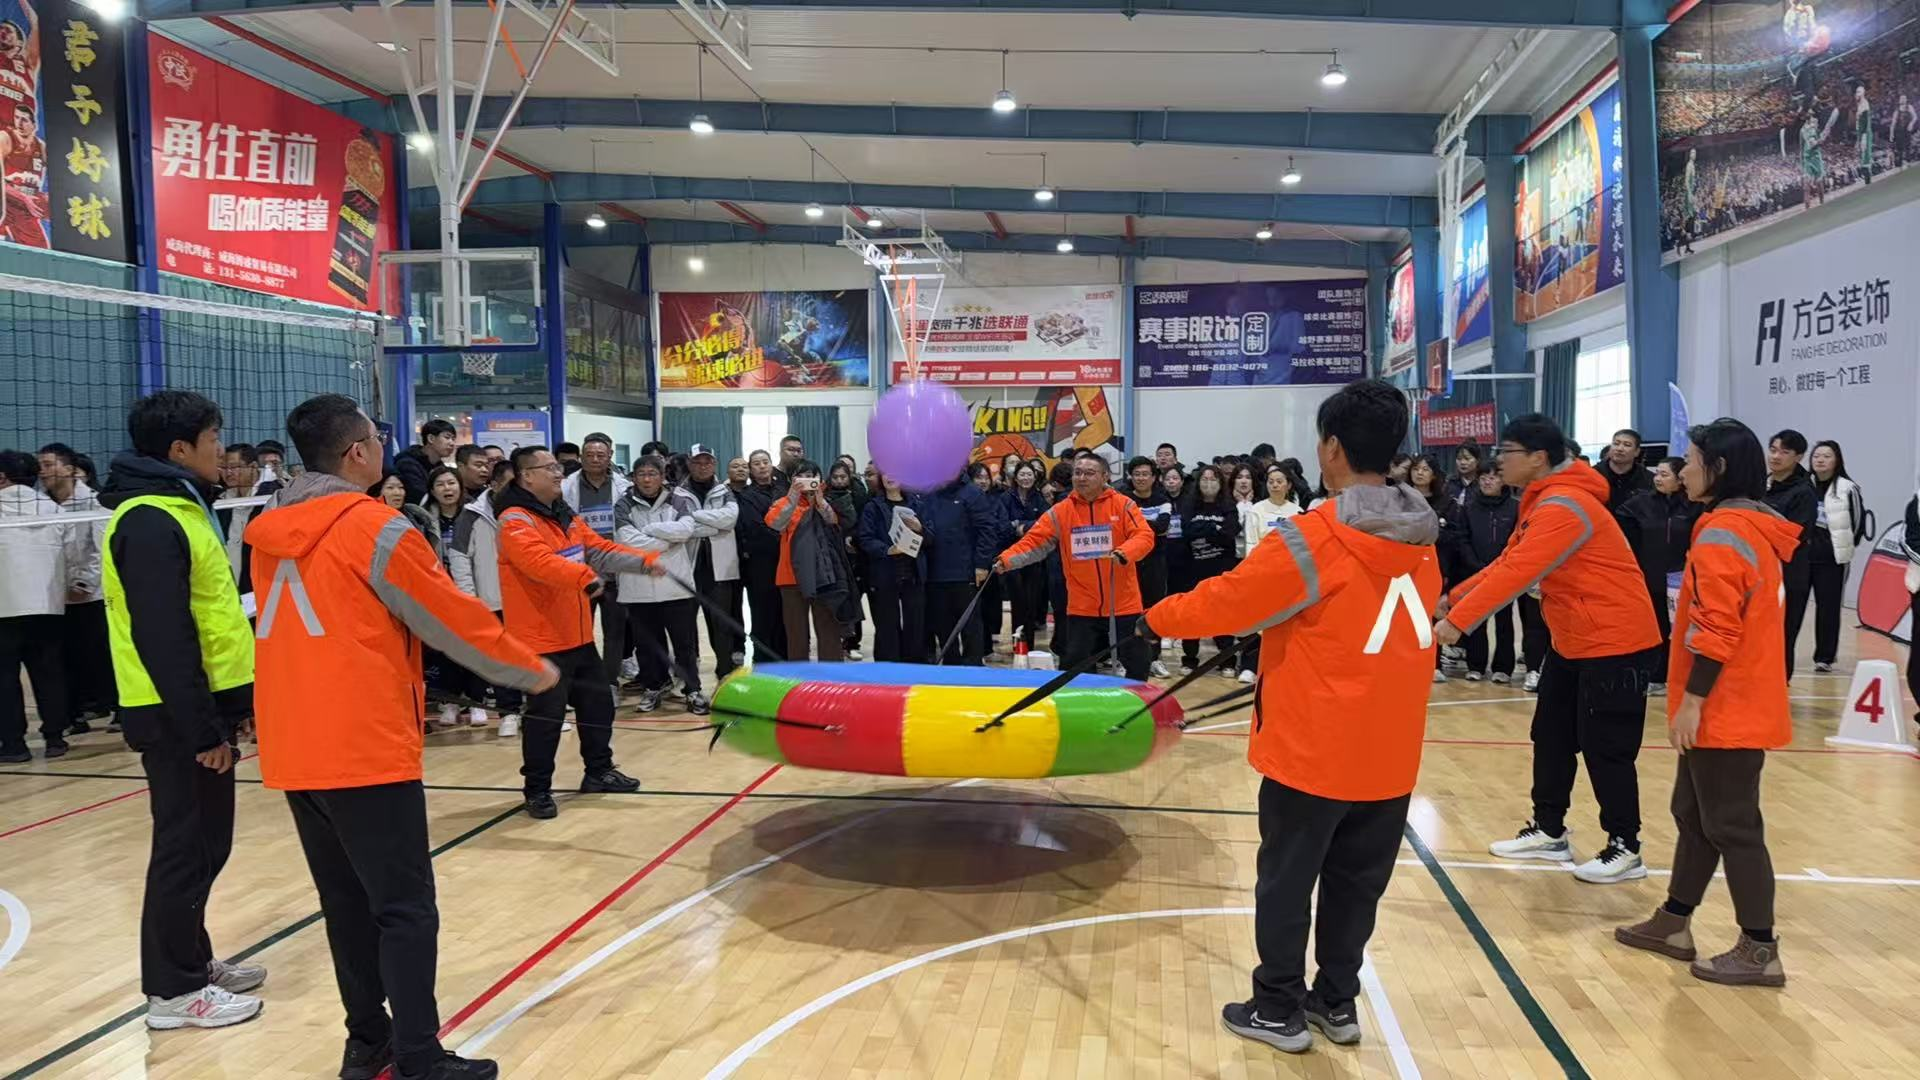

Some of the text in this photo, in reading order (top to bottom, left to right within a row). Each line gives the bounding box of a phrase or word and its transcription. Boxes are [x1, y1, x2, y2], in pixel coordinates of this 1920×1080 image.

[161, 117, 318, 186] 勇往直前
[208, 193, 329, 232] 喝体质能量
[1793, 278, 1890, 340] 方合装饰
[1139, 316, 1264, 352] 赛事服饰 定制
[974, 406, 1048, 433] KING!!
[1855, 678, 1884, 723] 4
